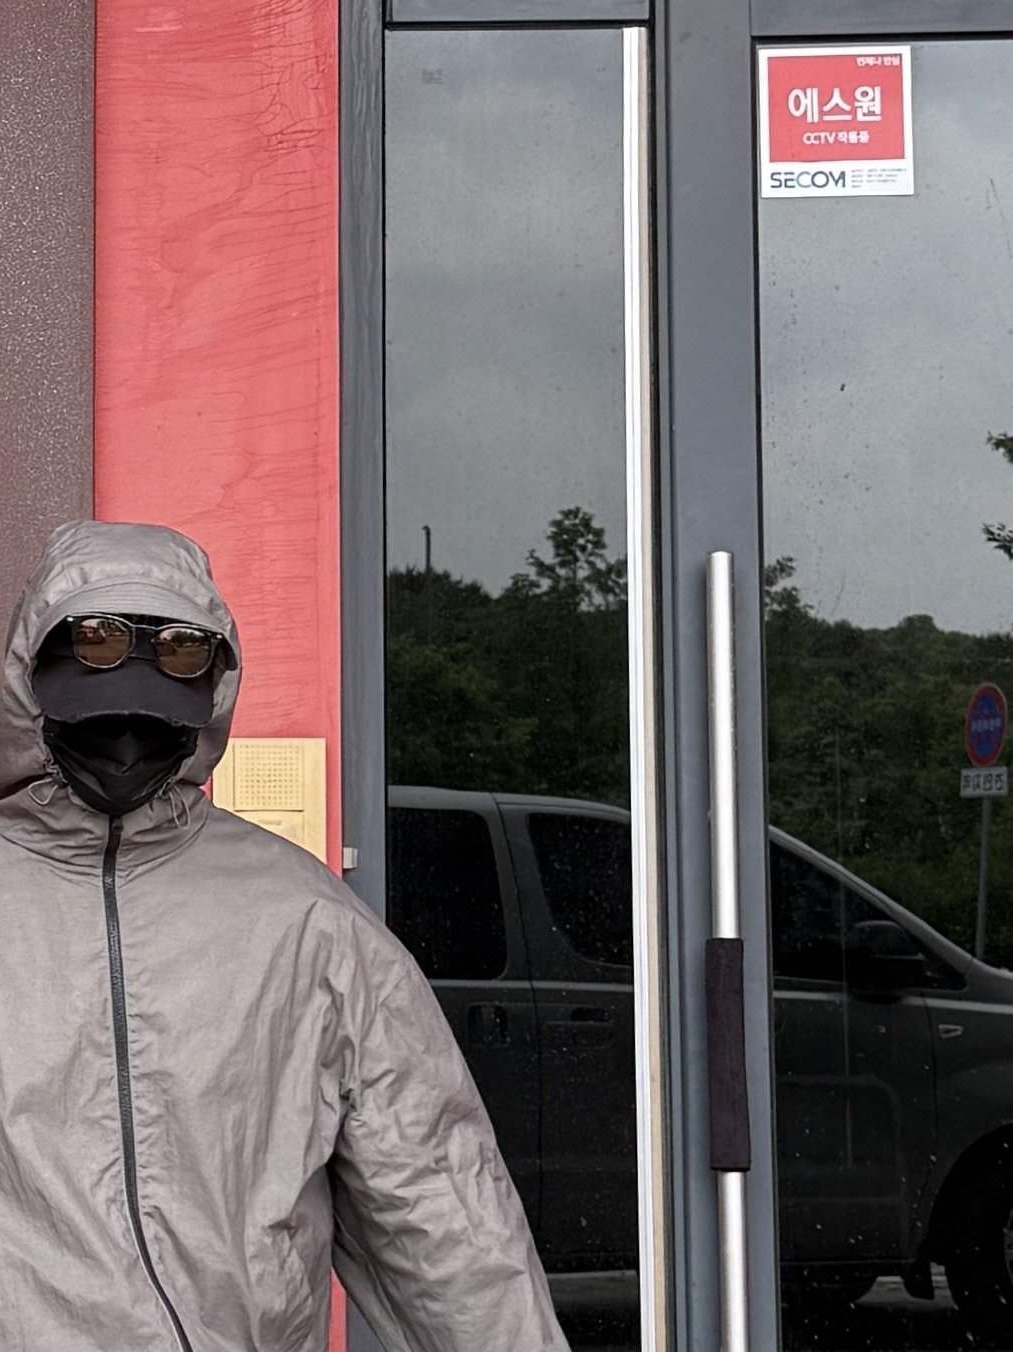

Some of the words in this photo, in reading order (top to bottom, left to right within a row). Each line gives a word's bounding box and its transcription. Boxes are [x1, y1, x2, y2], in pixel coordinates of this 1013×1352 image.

[788, 86, 882, 123] 에스원
[803, 132, 836, 144] CCTV
[837, 130, 870, 143] 작동중
[770, 170, 846, 189] SECOM
